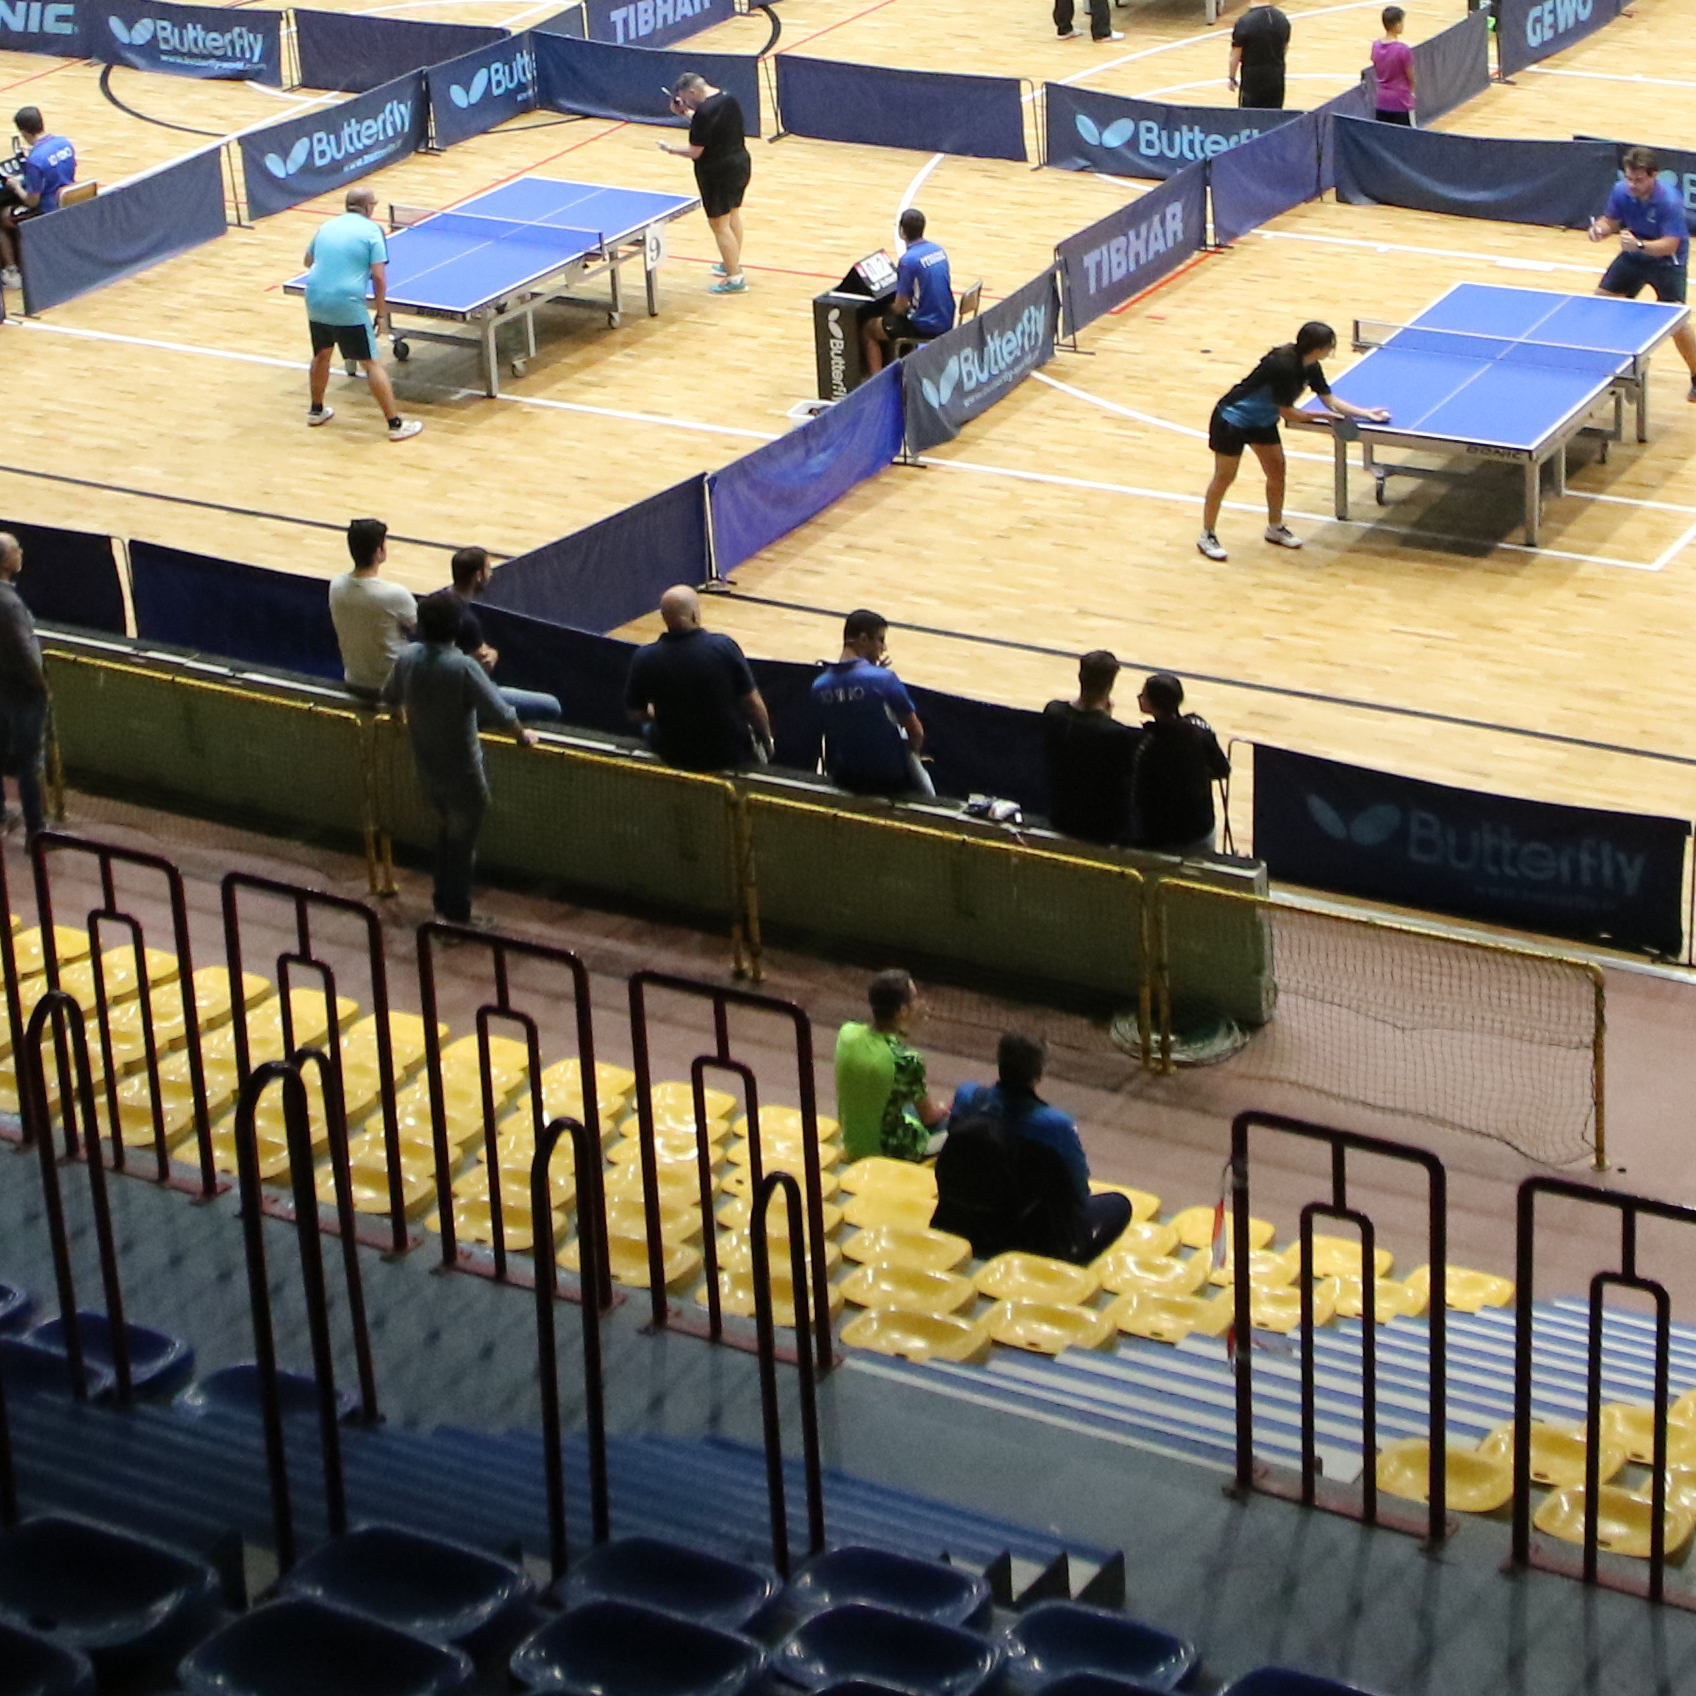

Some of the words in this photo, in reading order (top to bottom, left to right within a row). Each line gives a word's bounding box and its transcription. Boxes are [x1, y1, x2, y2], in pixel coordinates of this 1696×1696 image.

[156, 19, 264, 63] Butterfly
[312, 100, 411, 167] Butterfly
[649, 241, 661, 263] 9
[1083, 203, 1184, 295] TIBHAR
[959, 305, 1046, 391] Butterfly
[1407, 808, 1647, 896] Butterfly
